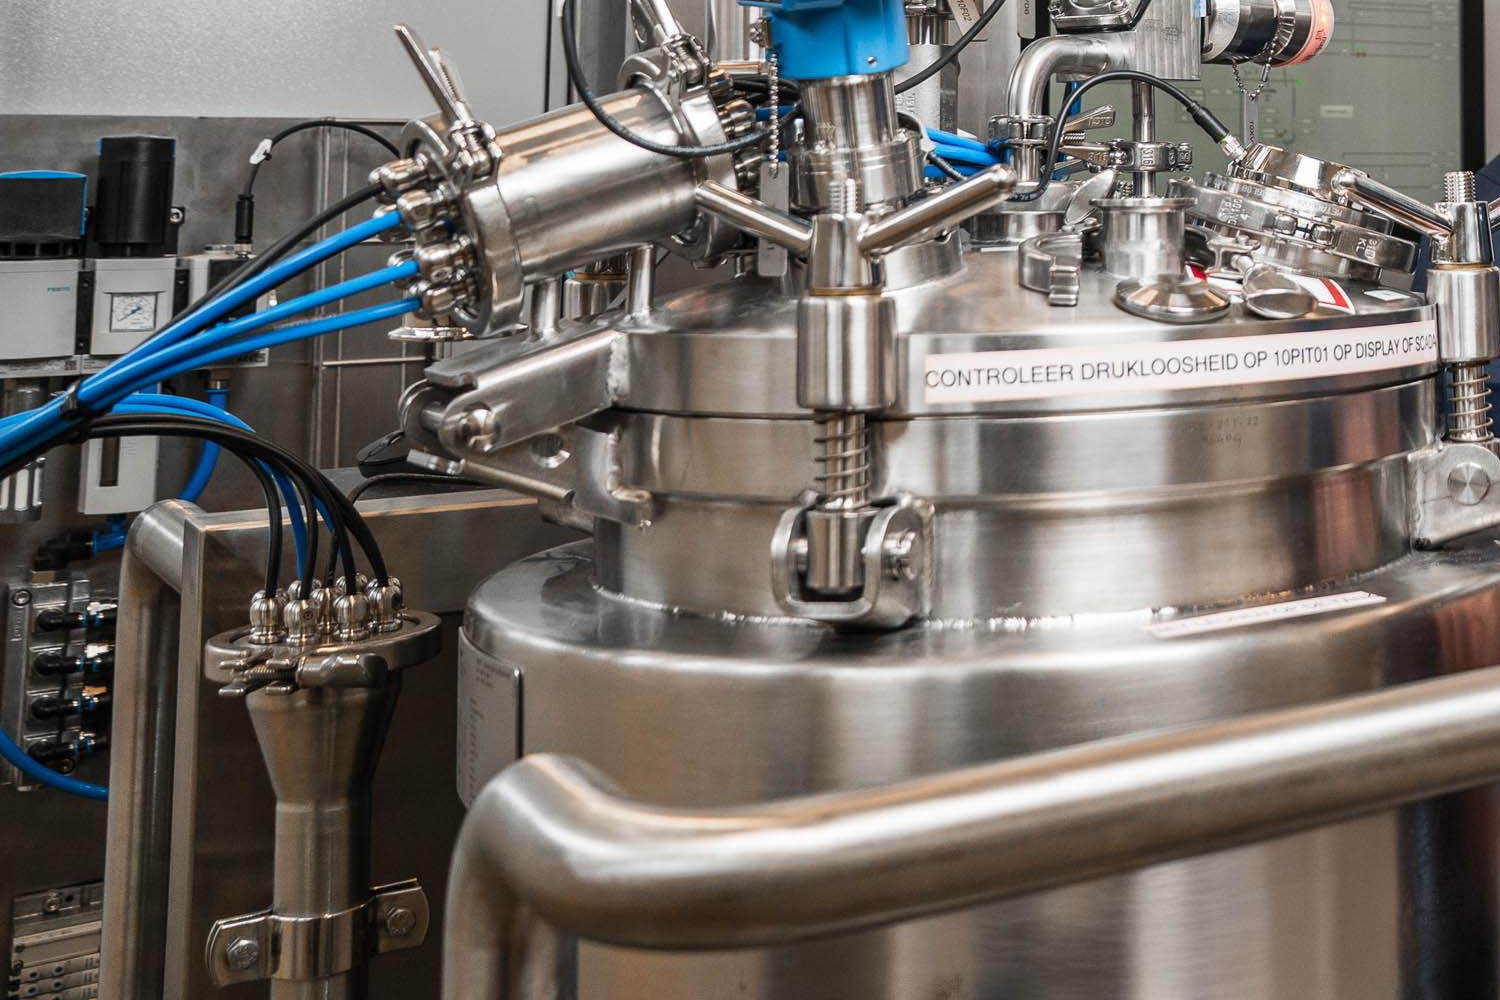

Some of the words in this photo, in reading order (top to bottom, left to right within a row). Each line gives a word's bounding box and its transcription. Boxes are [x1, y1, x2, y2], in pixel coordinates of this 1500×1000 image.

[924, 364, 1075, 388] CONTROLEER
[1081, 353, 1239, 381] DRUKLOOSHEID
[1243, 350, 1268, 369] OP
[1274, 346, 1329, 367] 10PIT01
[1333, 343, 1353, 361] OP
[1355, 338, 1401, 359] DISPLAY
[1402, 337, 1414, 354] OF
